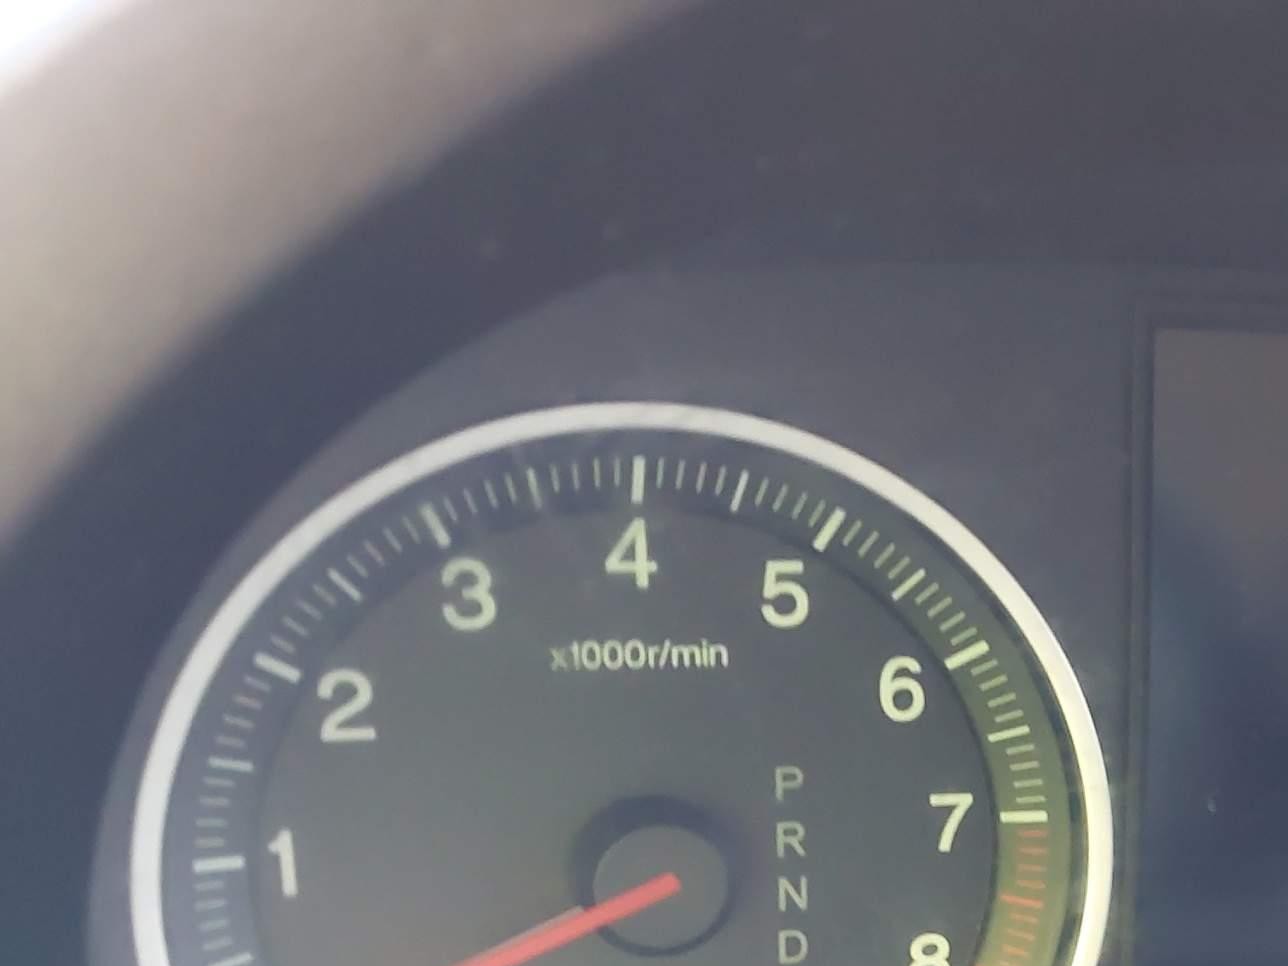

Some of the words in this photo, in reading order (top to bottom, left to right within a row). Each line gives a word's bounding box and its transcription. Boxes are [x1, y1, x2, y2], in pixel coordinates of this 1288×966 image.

[605, 517, 658, 590] 4
[440, 557, 497, 631] 3
[760, 559, 810, 628] 5
[549, 638, 729, 672] x1000r/min
[316, 668, 378, 743] 2
[879, 656, 926, 723] 6
[774, 765, 804, 802] P
[776, 821, 806, 858] R
[929, 793, 974, 853] 7
[268, 829, 298, 897] 1
[778, 875, 808, 912] N
[778, 930, 808, 965] D
